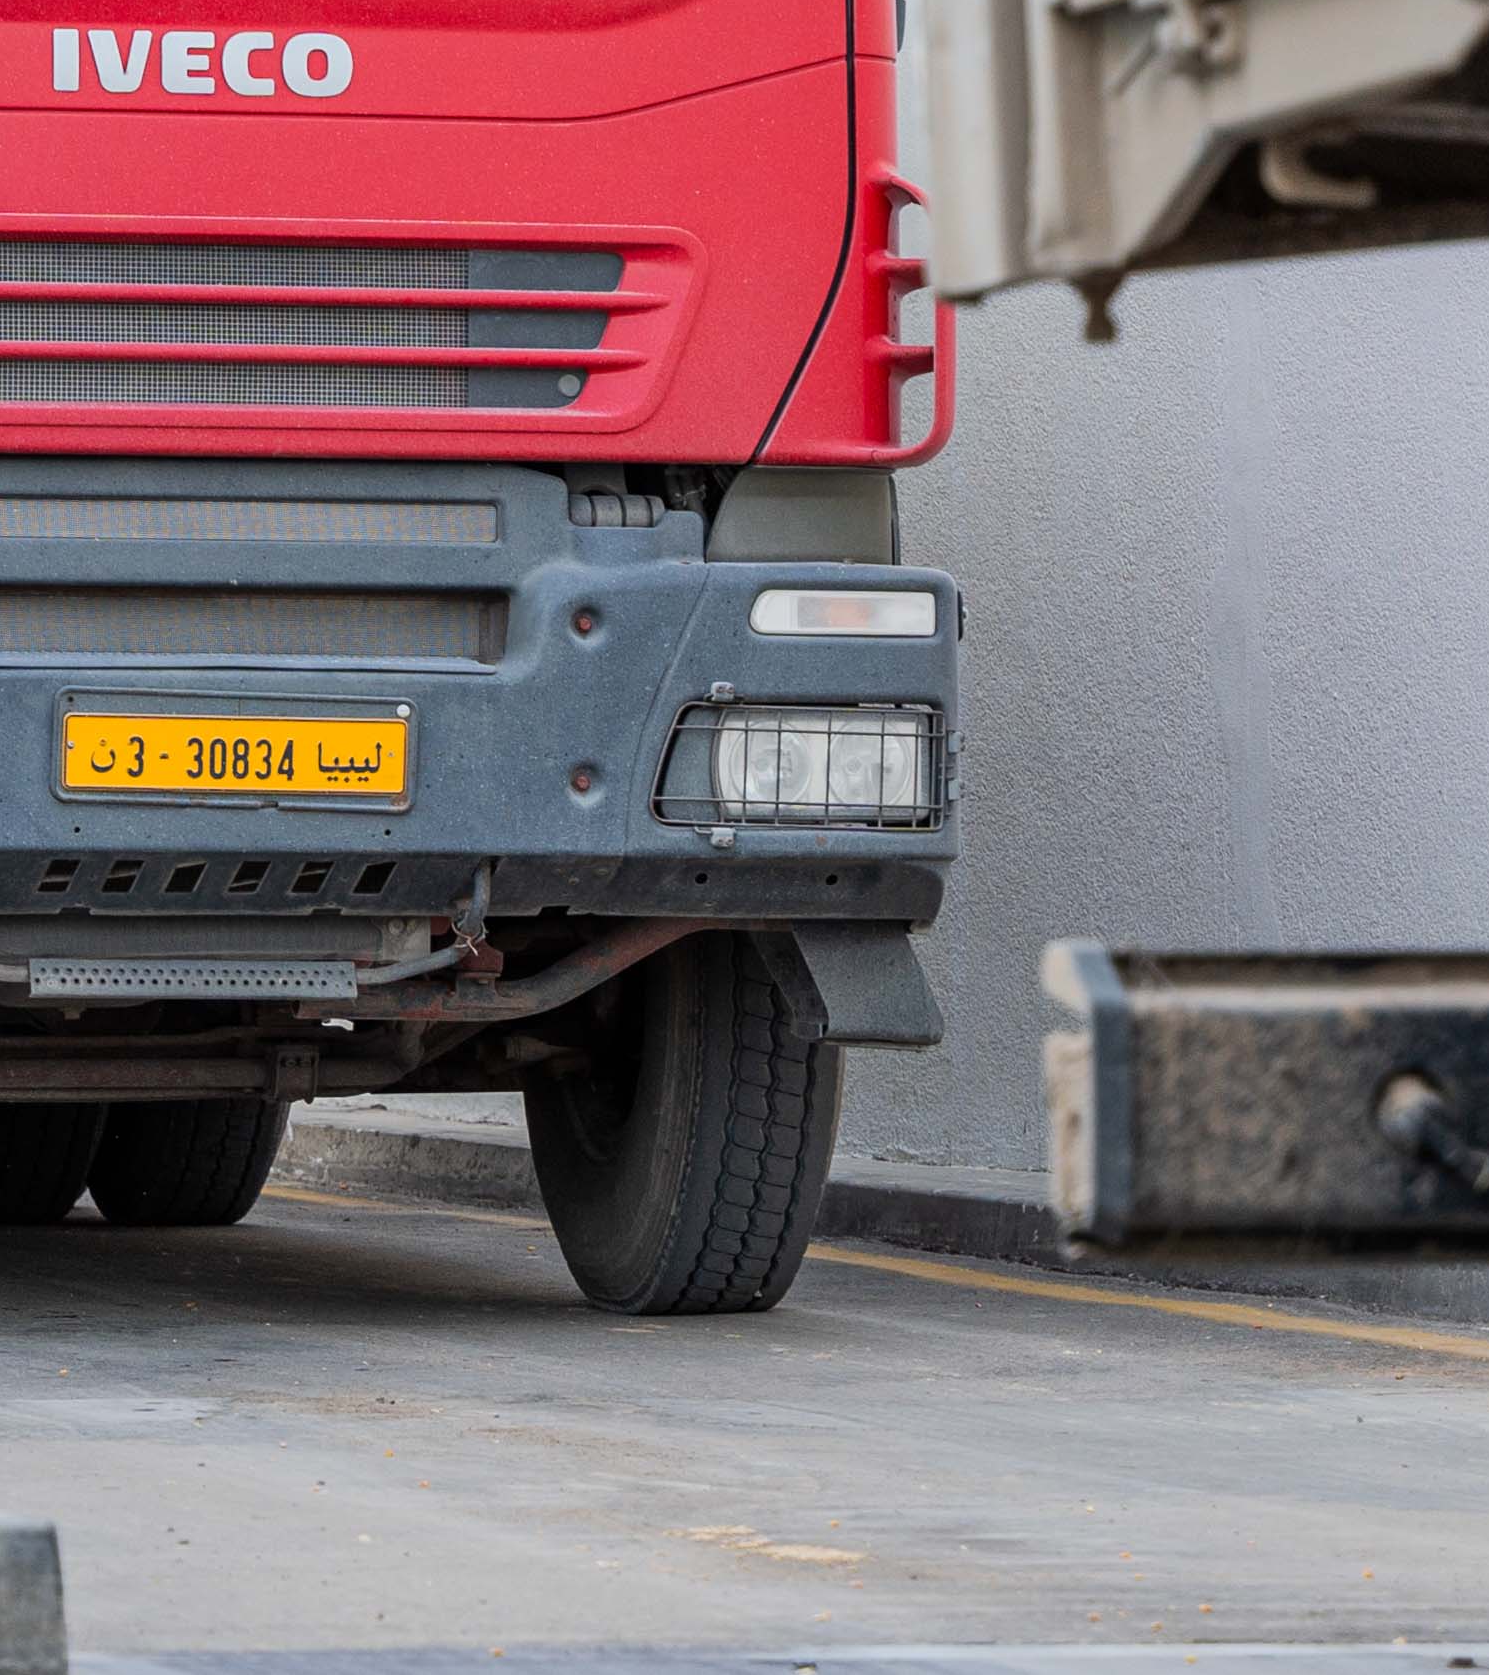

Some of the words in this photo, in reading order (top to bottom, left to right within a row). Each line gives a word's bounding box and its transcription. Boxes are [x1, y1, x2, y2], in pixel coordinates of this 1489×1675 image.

[52, 27, 354, 98] IVECO
[186, 737, 295, 781] 30834
[316, 740, 383, 784] ليبيا
